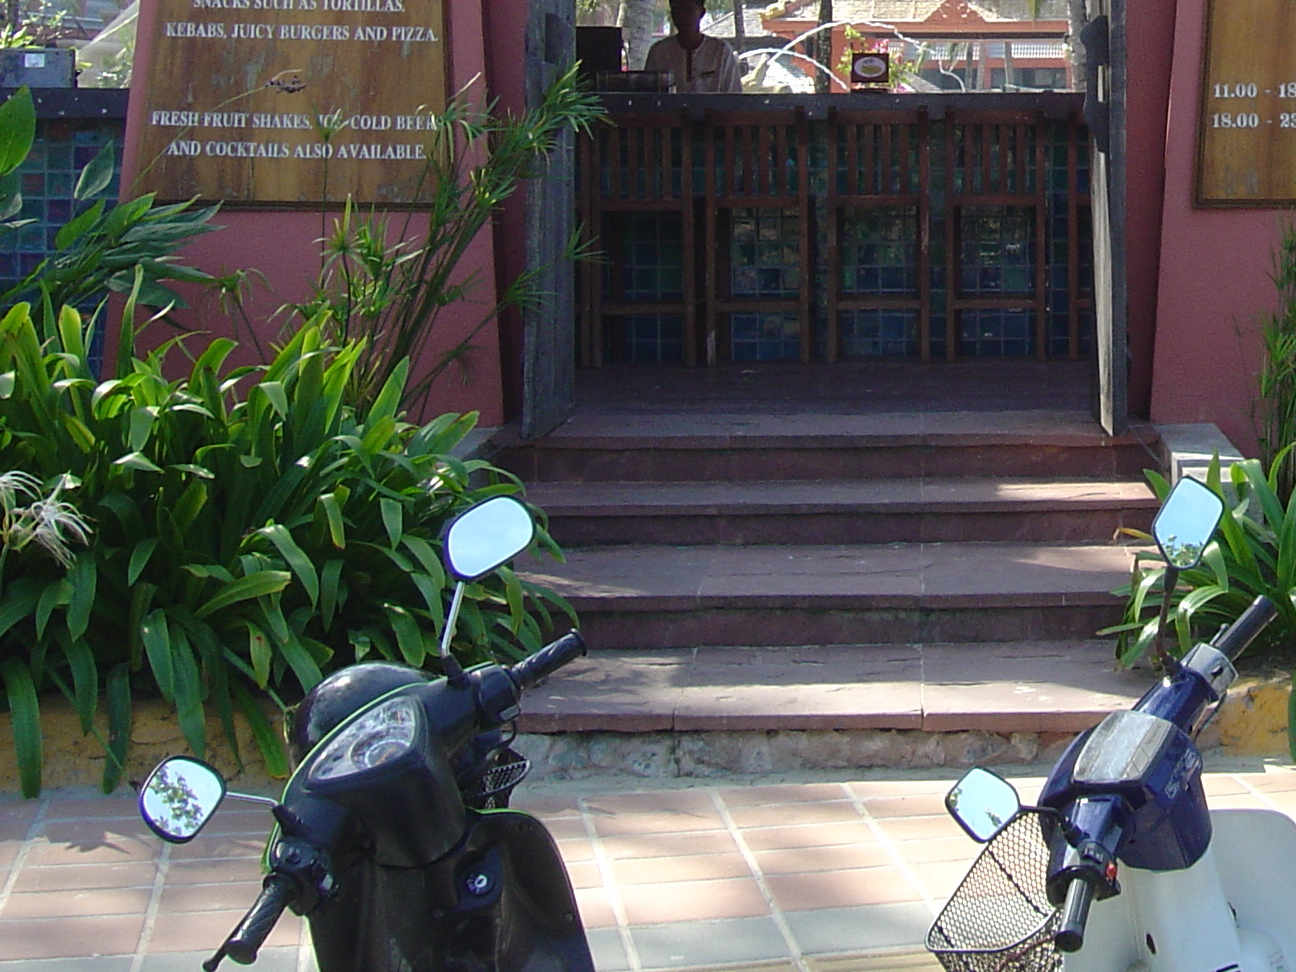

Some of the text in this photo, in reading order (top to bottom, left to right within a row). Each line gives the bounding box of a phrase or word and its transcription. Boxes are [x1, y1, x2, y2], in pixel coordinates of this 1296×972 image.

[166, 21, 439, 43] KEBABS, JUICY BURGERS AND PIZZA.
[1213, 83, 1258, 99] 11.00
[151, 110, 199, 127] FRESH
[203, 112, 248, 128] FRUIT
[350, 114, 392, 131] COLD
[1211, 112, 1259, 129] 18.00
[167, 139, 200, 156] AND
[205, 140, 290, 159] COCKTAILS
[294, 143, 333, 159] ALSO
